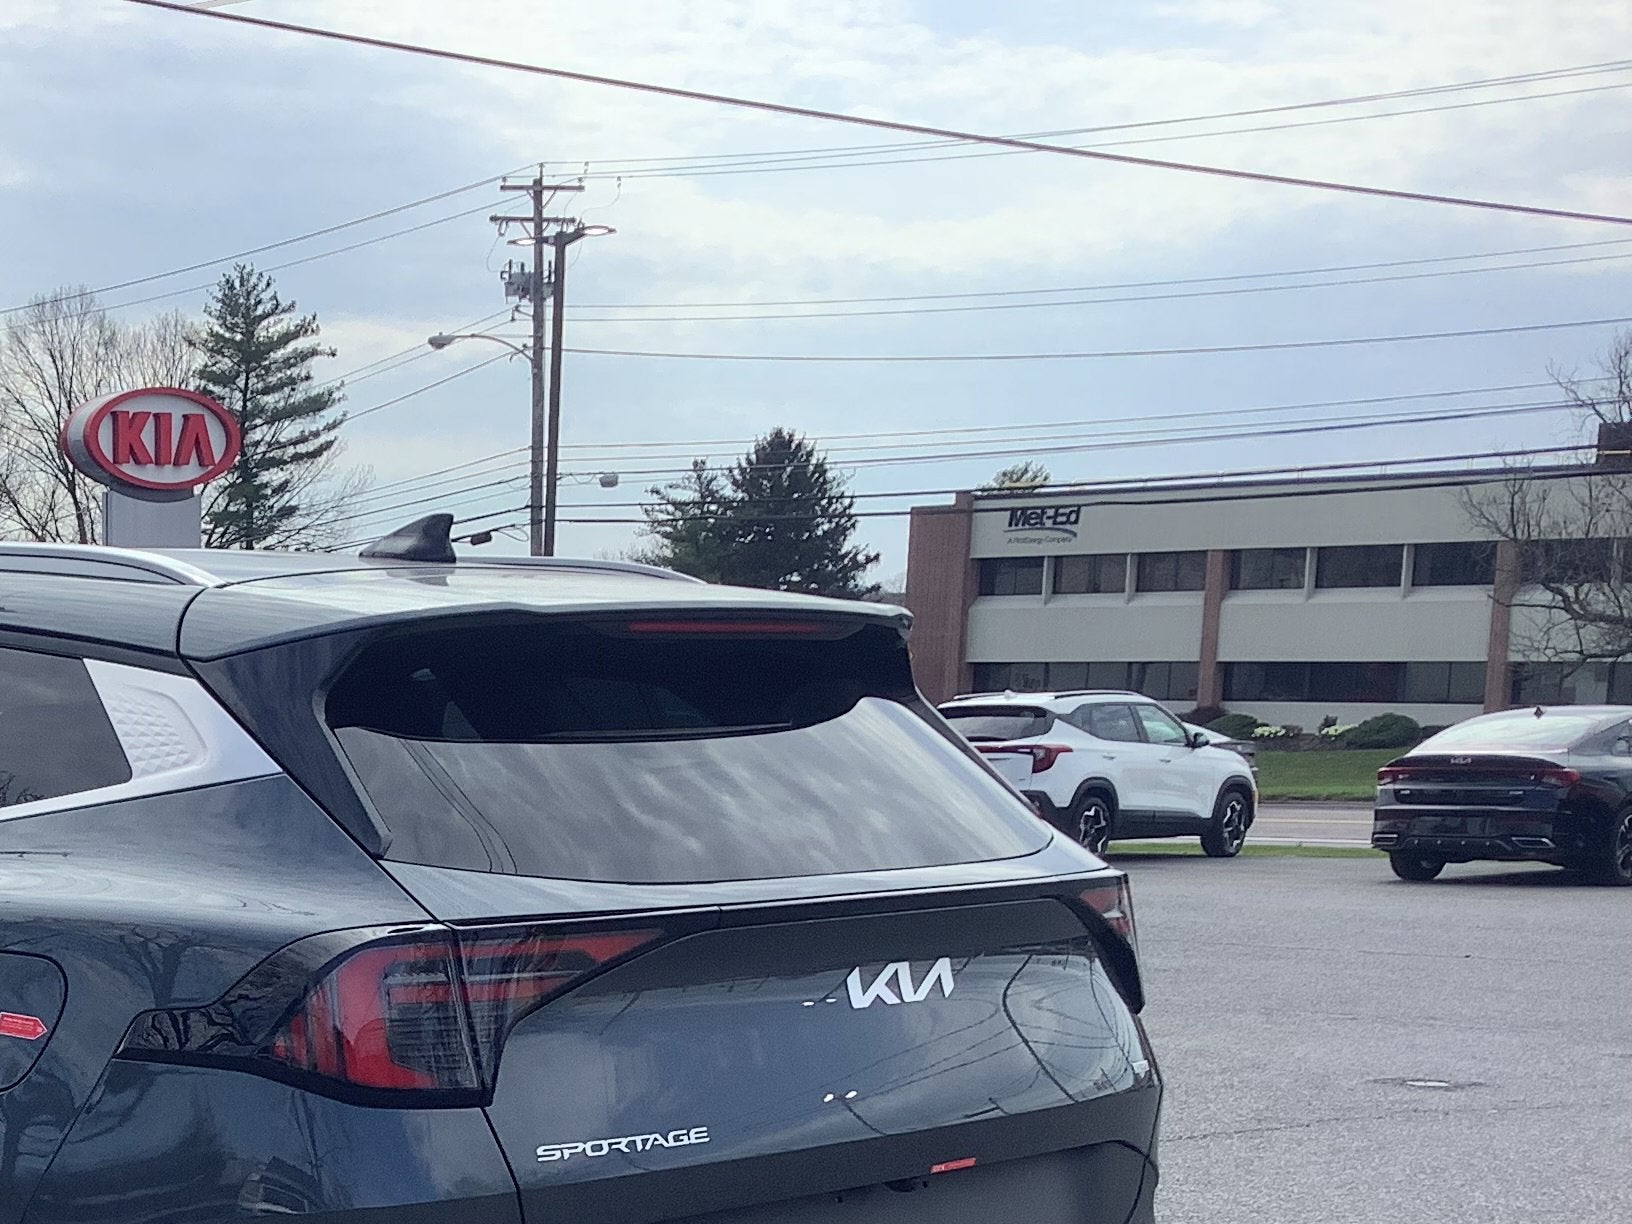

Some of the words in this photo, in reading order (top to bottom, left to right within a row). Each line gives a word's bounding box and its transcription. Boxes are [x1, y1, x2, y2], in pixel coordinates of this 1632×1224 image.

[110, 411, 216, 467] KIA
[1007, 506, 1082, 528] Met-Ed
[846, 957, 955, 1009] KIA
[536, 1126, 710, 1162] SPORTAGE
